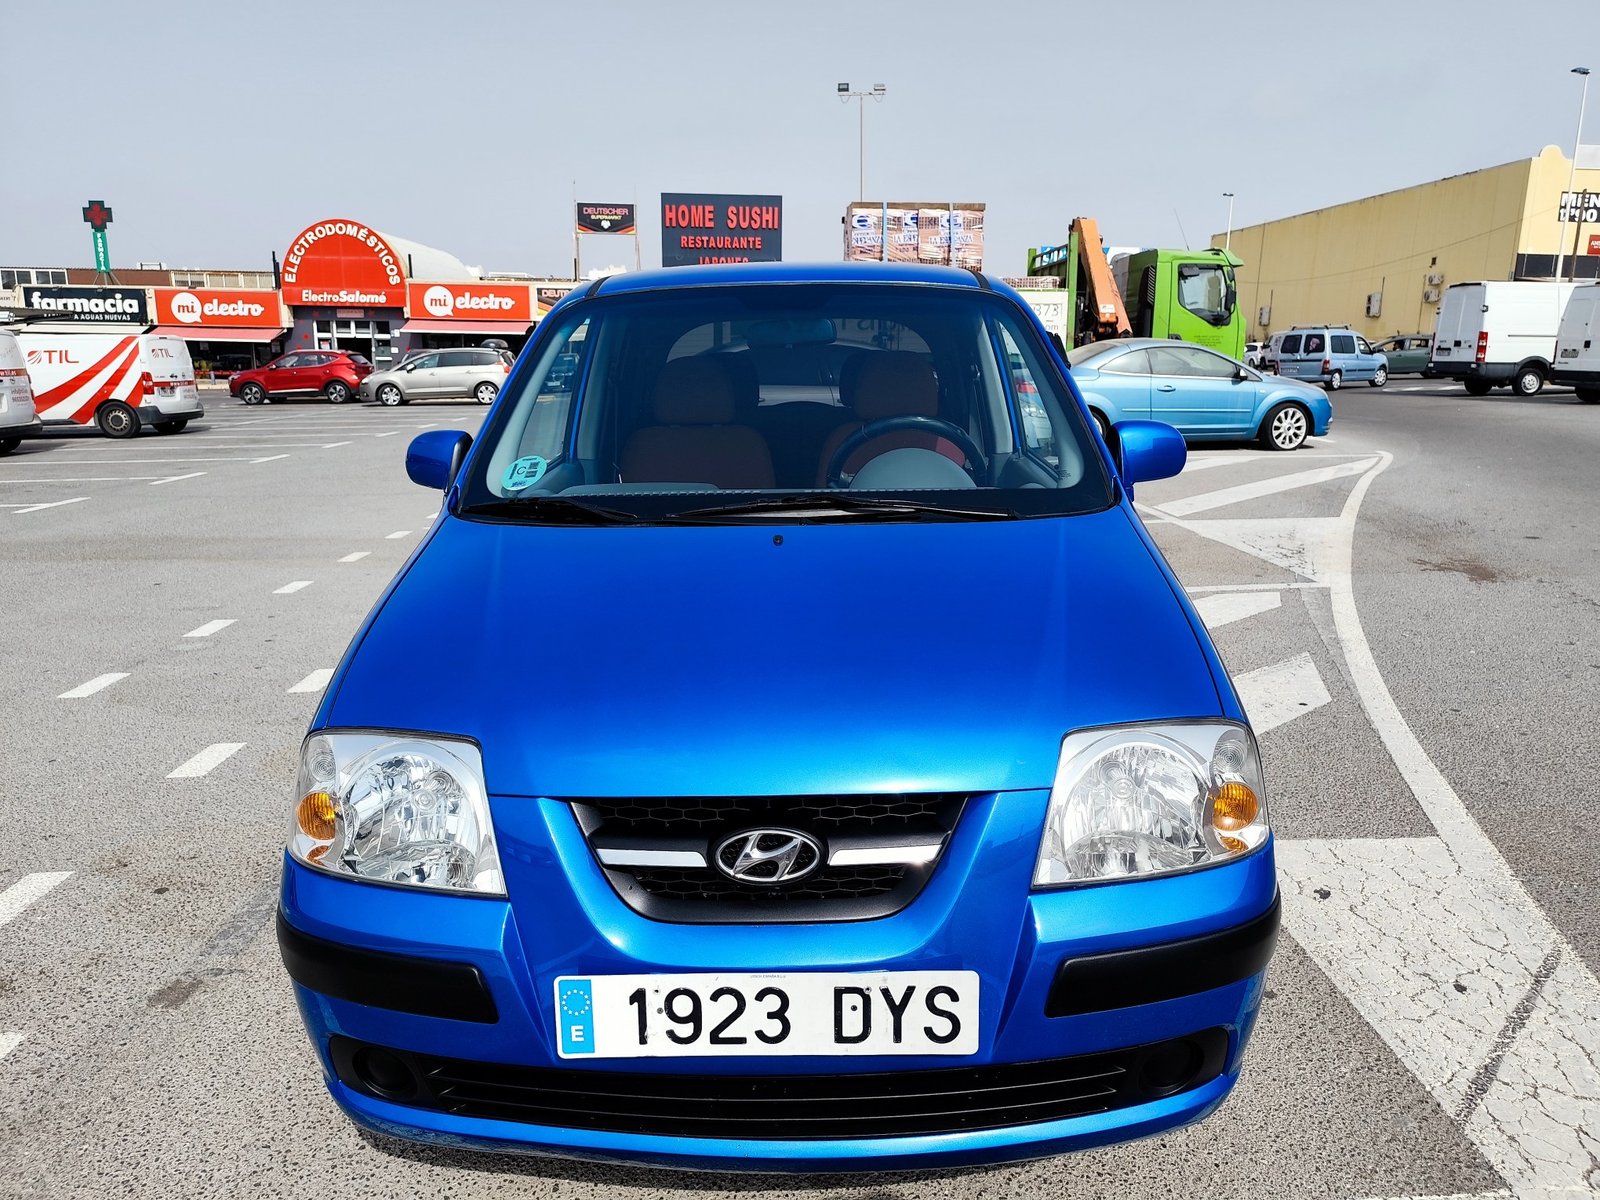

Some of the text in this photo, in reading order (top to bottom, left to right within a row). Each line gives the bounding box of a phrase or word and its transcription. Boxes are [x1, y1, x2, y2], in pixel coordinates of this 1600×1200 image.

[583, 207, 629, 215] DEUTSCHER
[664, 204, 779, 230] HOME SUSHI
[680, 236, 762, 250] RESTAURANTE
[284, 222, 401, 286] ELECTRODOMÉSTICOS
[31, 291, 139, 313] farmacia
[302, 289, 387, 304] ElectroSalomé
[429, 292, 515, 310] mi electro
[177, 298, 264, 316] mi electro
[43, 350, 79, 364] TIL
[158, 348, 173, 358] TIL
[629, 985, 962, 1046] 1923 DYS
[571, 1025, 585, 1042] E
